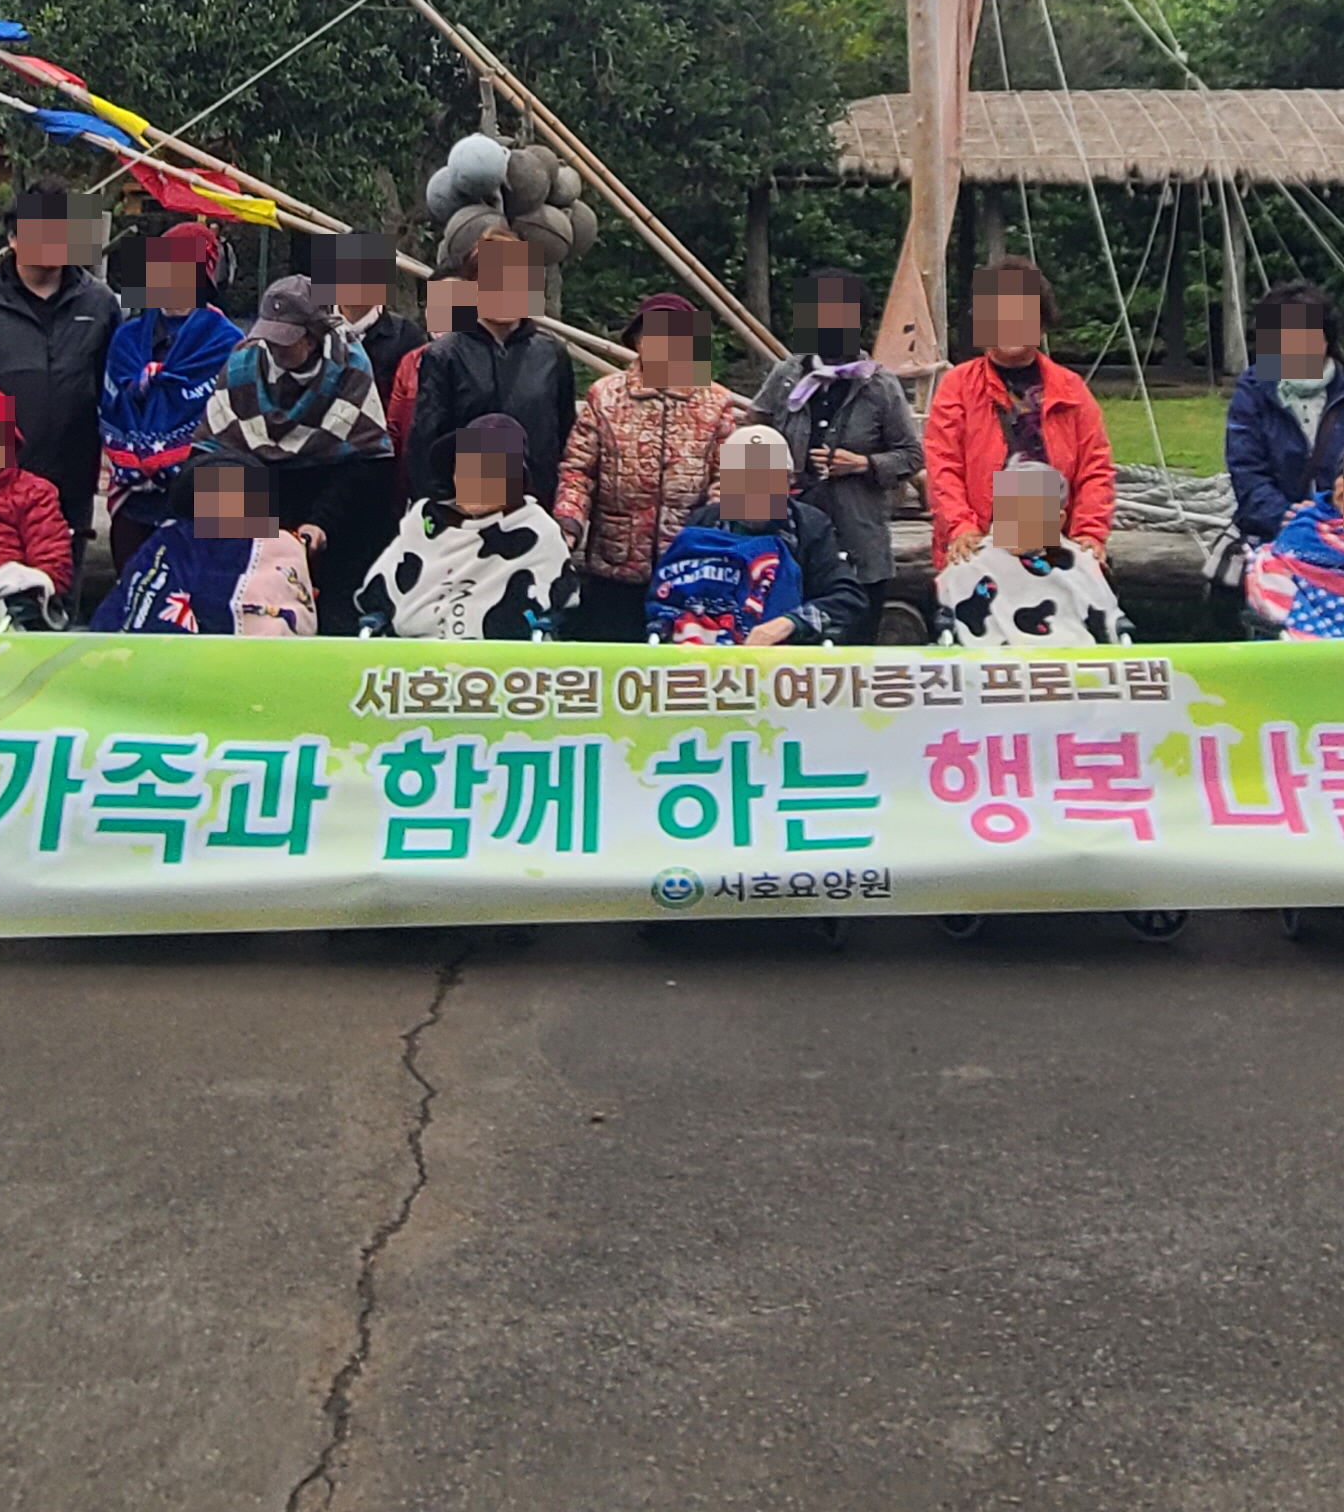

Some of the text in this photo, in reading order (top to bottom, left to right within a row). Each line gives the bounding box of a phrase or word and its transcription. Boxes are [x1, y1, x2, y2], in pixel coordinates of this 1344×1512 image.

[356, 660, 1171, 714] 서호요양원 어르신 여가증진 프로그램
[378, 738, 601, 860] 함께
[654, 737, 881, 852] 하는
[922, 729, 1156, 843] 행복
[713, 867, 892, 903] 서호요양원
